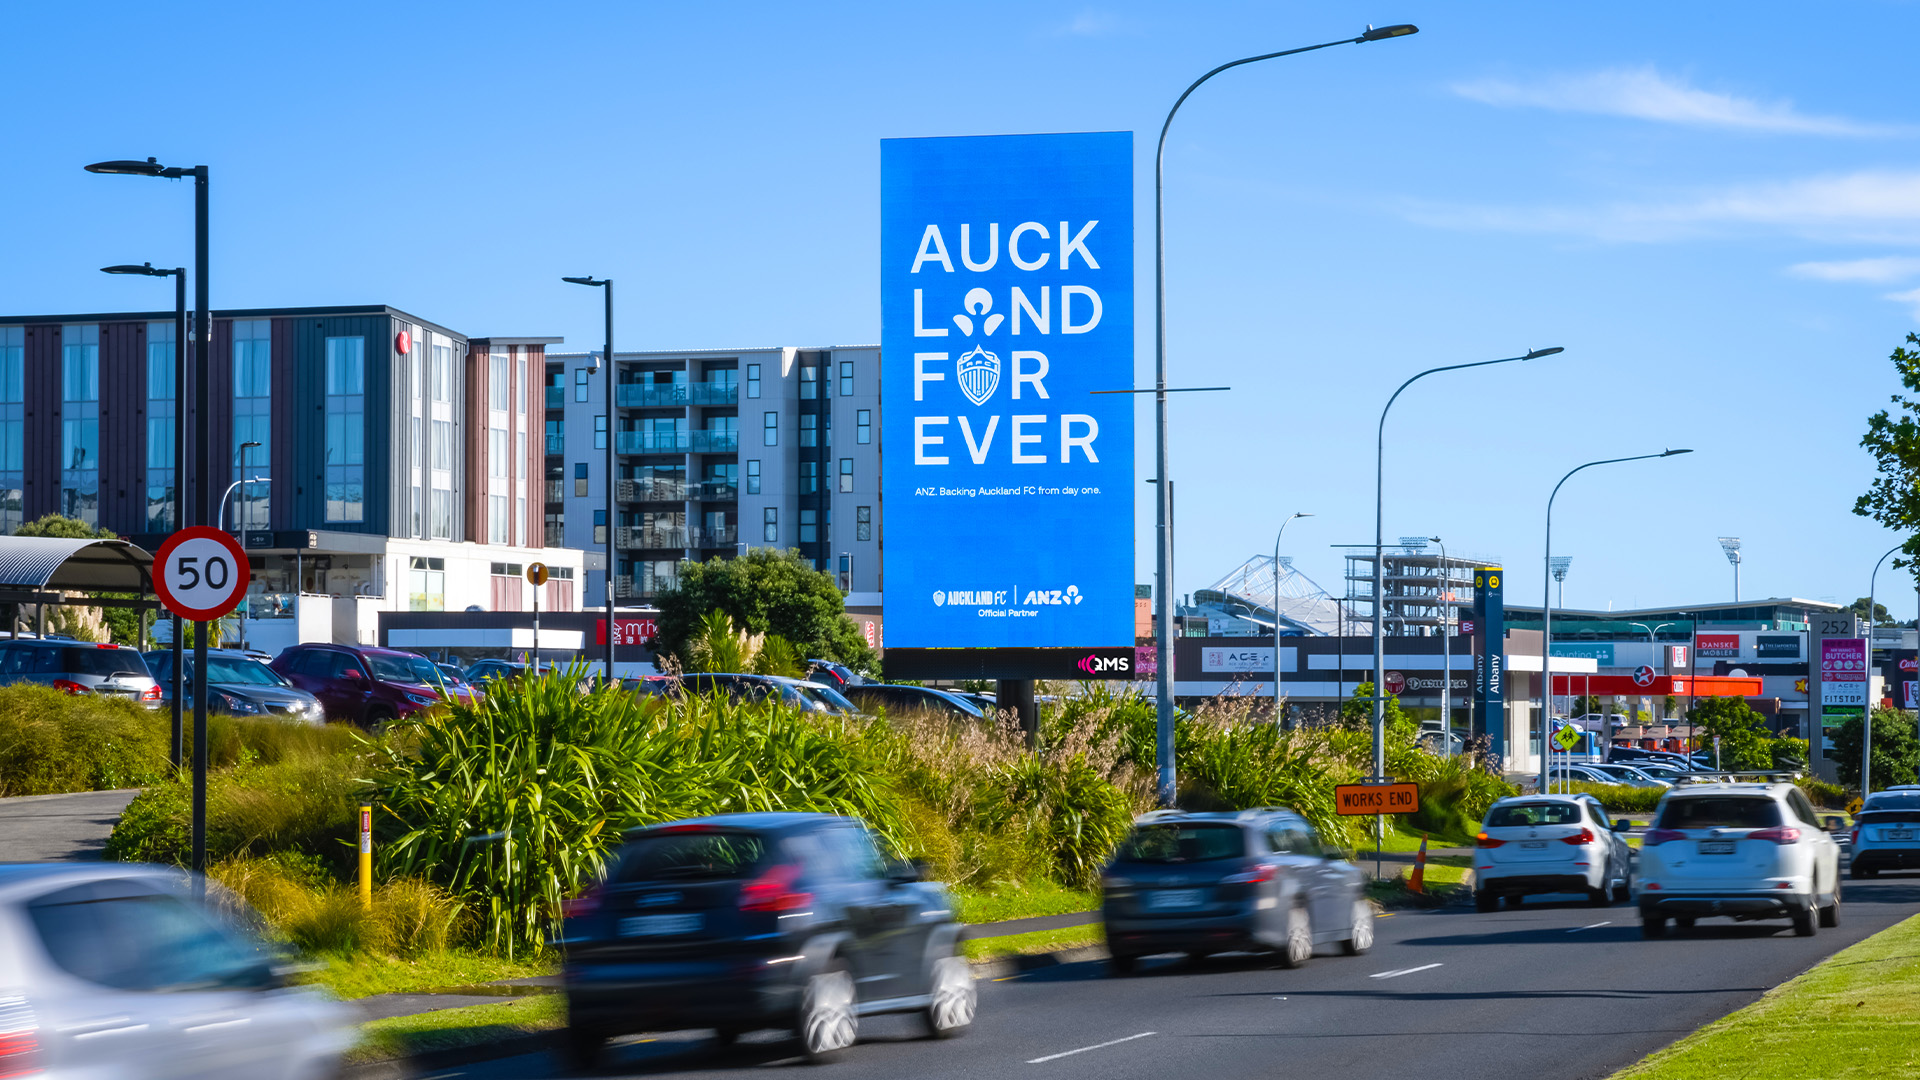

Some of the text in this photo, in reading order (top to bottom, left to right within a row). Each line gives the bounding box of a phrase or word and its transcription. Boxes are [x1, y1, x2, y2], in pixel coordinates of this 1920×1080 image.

[911, 220, 1100, 273] AUCK
[914, 414, 1100, 465] EVER
[915, 485, 1101, 498] ANZ. Backing Auckland FC from day one.
[178, 556, 228, 590] 50
[947, 590, 1008, 606] AUCKLAND FC
[1023, 590, 1062, 605] ANZ
[978, 608, 1039, 617] Official Partner
[1821, 620, 1849, 634] 252
[1086, 654, 1129, 675] QMS
[1476, 654, 1485, 693] Albany
[1489, 654, 1501, 693] Albany
[1824, 695, 1864, 703] FITSTOP.
[1342, 791, 1412, 807] WORKS END
